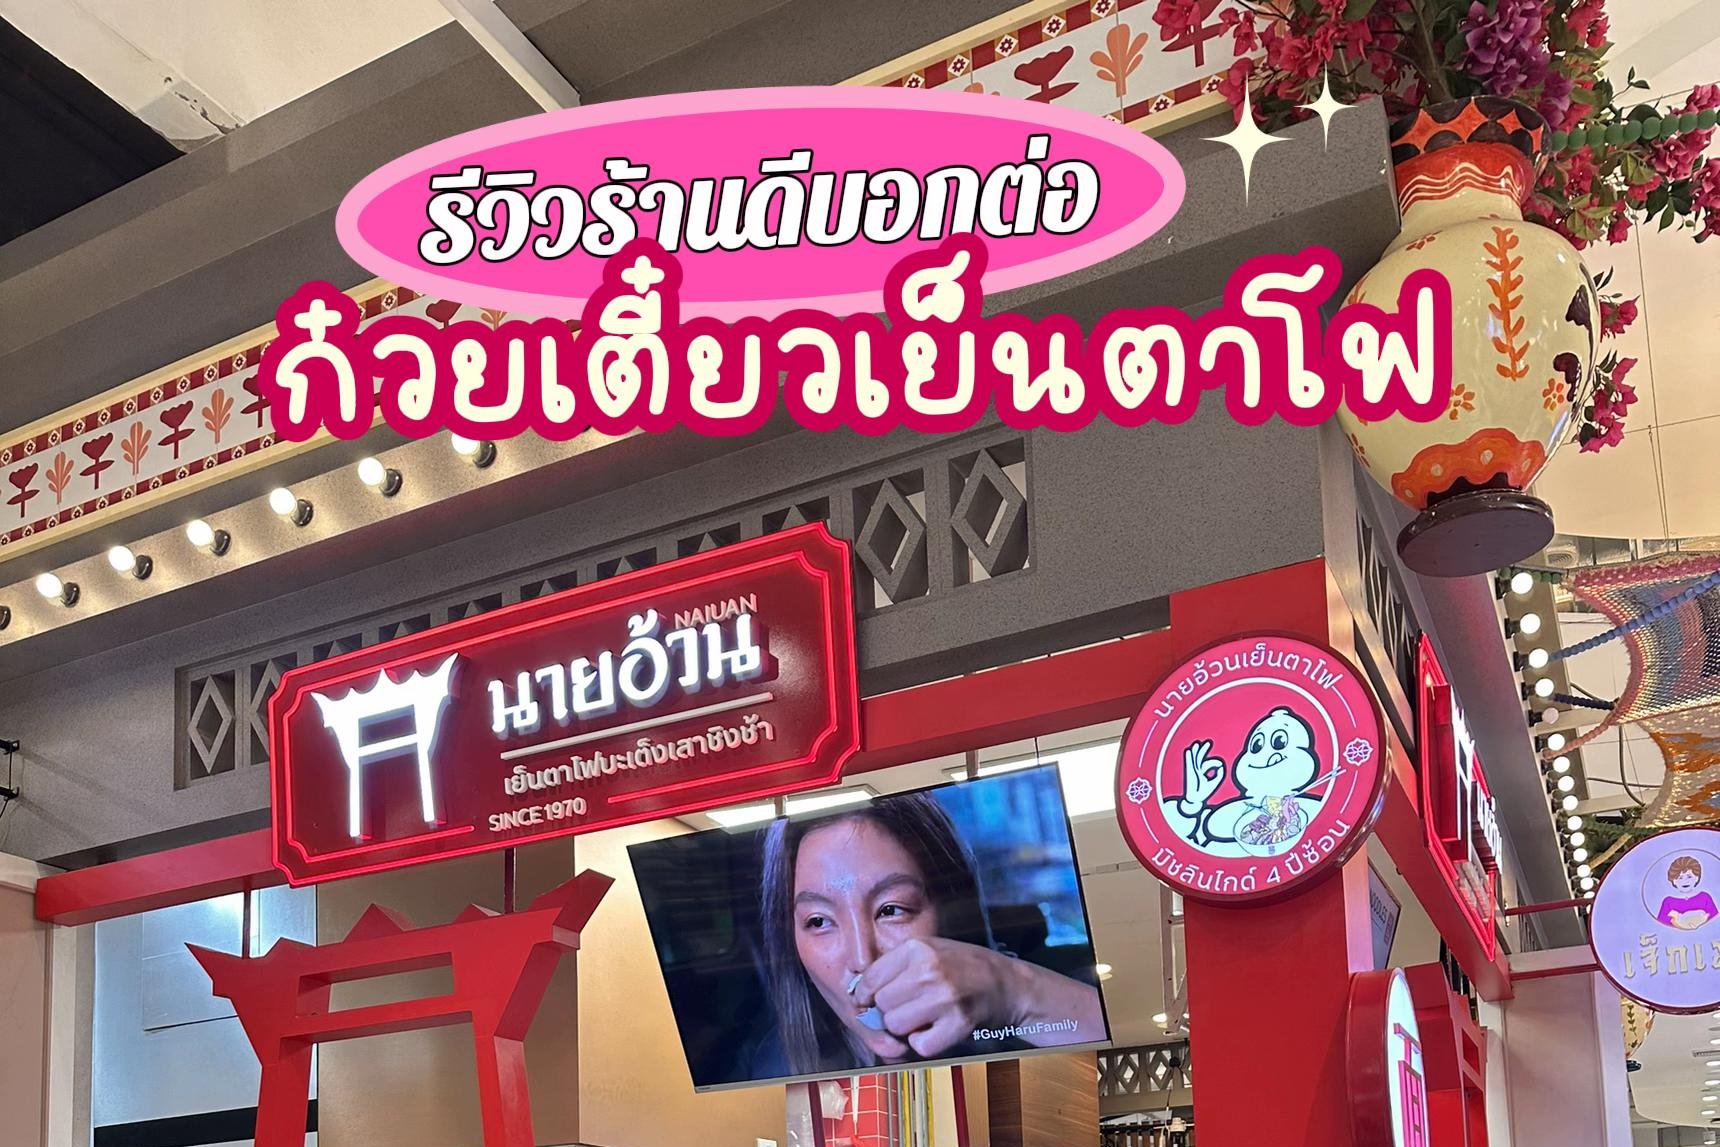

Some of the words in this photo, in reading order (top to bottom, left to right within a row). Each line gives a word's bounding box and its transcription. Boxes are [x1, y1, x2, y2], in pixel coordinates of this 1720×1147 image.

[674, 593, 758, 630] NAIUAN
[487, 608, 762, 736] นายอ้วน
[1153, 642, 1344, 719] นายอ้วนเย็นตาโฟ
[488, 805, 543, 833] SINCE
[543, 796, 588, 821] 1970
[1151, 847, 1258, 892] มิชลินไกด์
[1266, 866, 1282, 884] 4
[1284, 818, 1352, 877] ปีซ้อน
[973, 1018, 1079, 1042] #GuyHaruFamily
